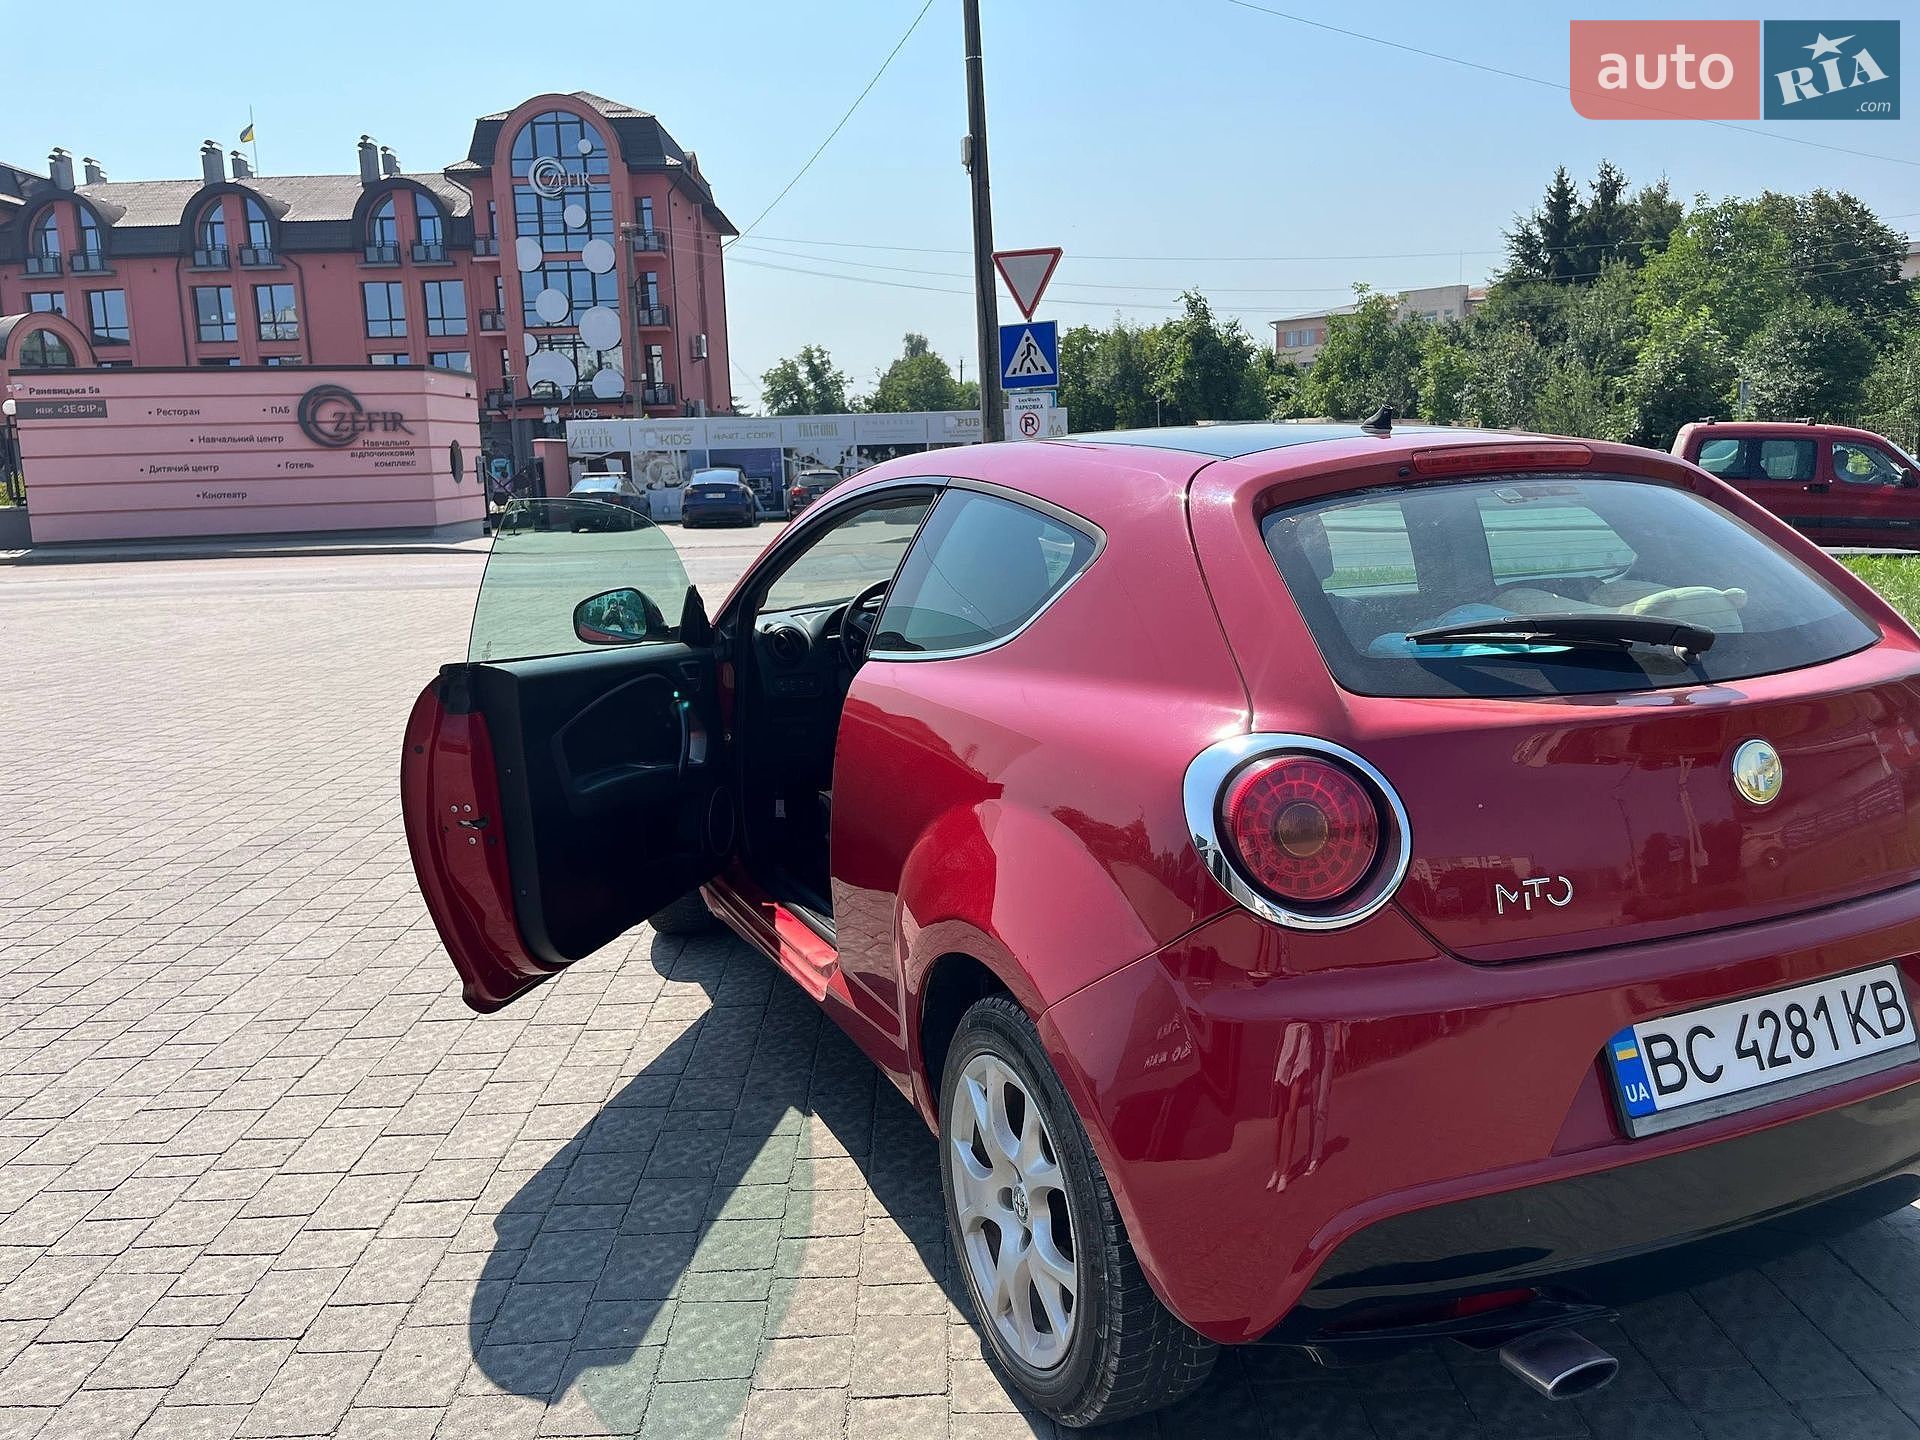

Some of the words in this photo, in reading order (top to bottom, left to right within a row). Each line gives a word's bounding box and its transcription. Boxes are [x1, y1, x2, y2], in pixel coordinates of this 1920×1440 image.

[156, 407, 200, 417] Ресторан
[573, 408, 598, 419] KIDS
[332, 411, 416, 435] ZEFIR
[957, 417, 981, 427] PUB
[198, 434, 255, 444] Навчальний
[256, 434, 284, 444] центр
[362, 439, 410, 448] Навчально
[571, 435, 615, 448] ZEFIR
[660, 434, 692, 446] KIDS
[350, 449, 416, 459] відпочинковий
[149, 464, 190, 474] Дитячий
[191, 464, 220, 474] центр
[285, 461, 315, 470] Готель
[374, 460, 417, 468] комплекс
[202, 490, 248, 501] Кінотеатр
[1642, 1025, 1724, 1096] BC
[1735, 995, 1840, 1071] 4281
[1840, 979, 1906, 1045] KB
[1625, 1081, 1651, 1103] UA
